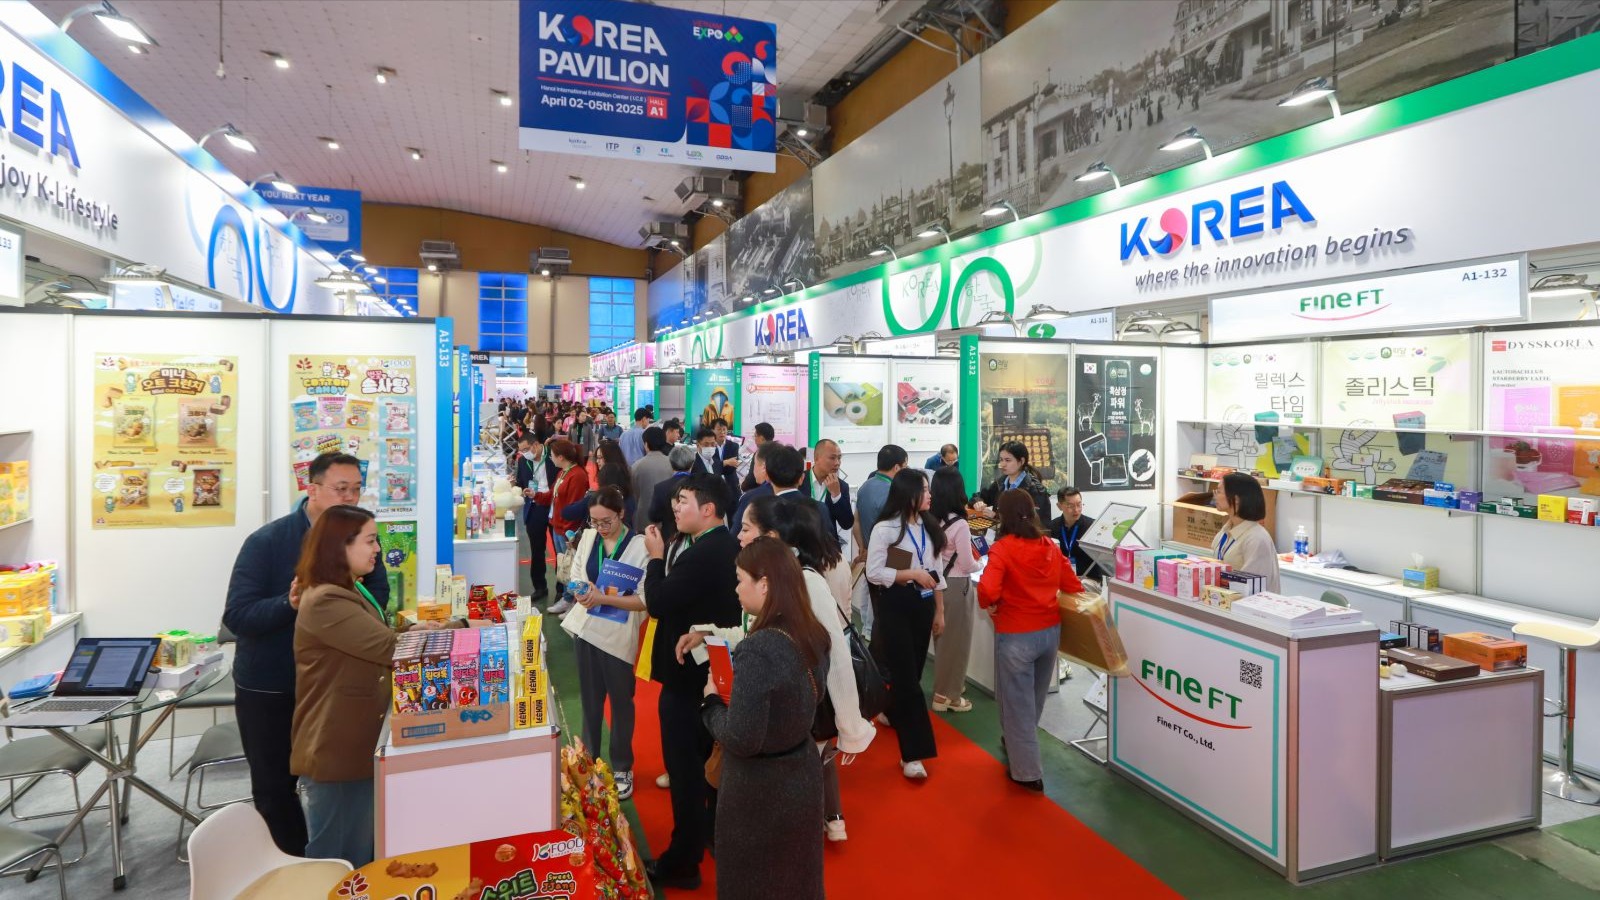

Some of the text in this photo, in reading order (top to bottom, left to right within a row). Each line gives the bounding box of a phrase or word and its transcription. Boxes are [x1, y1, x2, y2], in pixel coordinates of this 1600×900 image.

[538, 11, 668, 57] KOREA
[693, 26, 723, 40] EXPO
[538, 48, 669, 88] PAVILION
[541, 84, 556, 92] Hanoi
[557, 86, 588, 96] International
[588, 90, 612, 98] Exhibition
[613, 93, 630, 101] Center
[541, 94, 644, 115] April 02-05th 2025
[649, 98, 665, 106] HALL
[650, 106, 665, 117] A1
[605, 142, 619, 150] ITP
[37, 171, 119, 231] K-Lifestyle
[262, 190, 331, 203] YOU NEXT YEAR
[1120, 180, 1317, 261] KOREA
[1135, 226, 1410, 287] where the innovation begins
[1461, 267, 1508, 283] A1-132
[1356, 289, 1385, 307] FT
[754, 308, 810, 347] KOREA
[439, 329, 449, 368] A1-133
[1508, 339, 1595, 350] DYSSKOREA
[460, 352, 468, 377] A1-134
[160, 368, 187, 379] 미니
[1255, 372, 1305, 389] 릴렉스
[303, 378, 349, 388] COTTON
[306, 386, 345, 395] CANDY
[1345, 376, 1434, 397] 졸리스틱
[1110, 397, 1126, 409] 파워
[1270, 396, 1304, 413] 타임
[602, 569, 639, 582] CATALOGUE
[1208, 686, 1243, 720] FT
[1156, 715, 1216, 751] Fine FT Co., Ltd.
[551, 837, 584, 854] FOOD
[547, 872, 572, 881] Sweet
